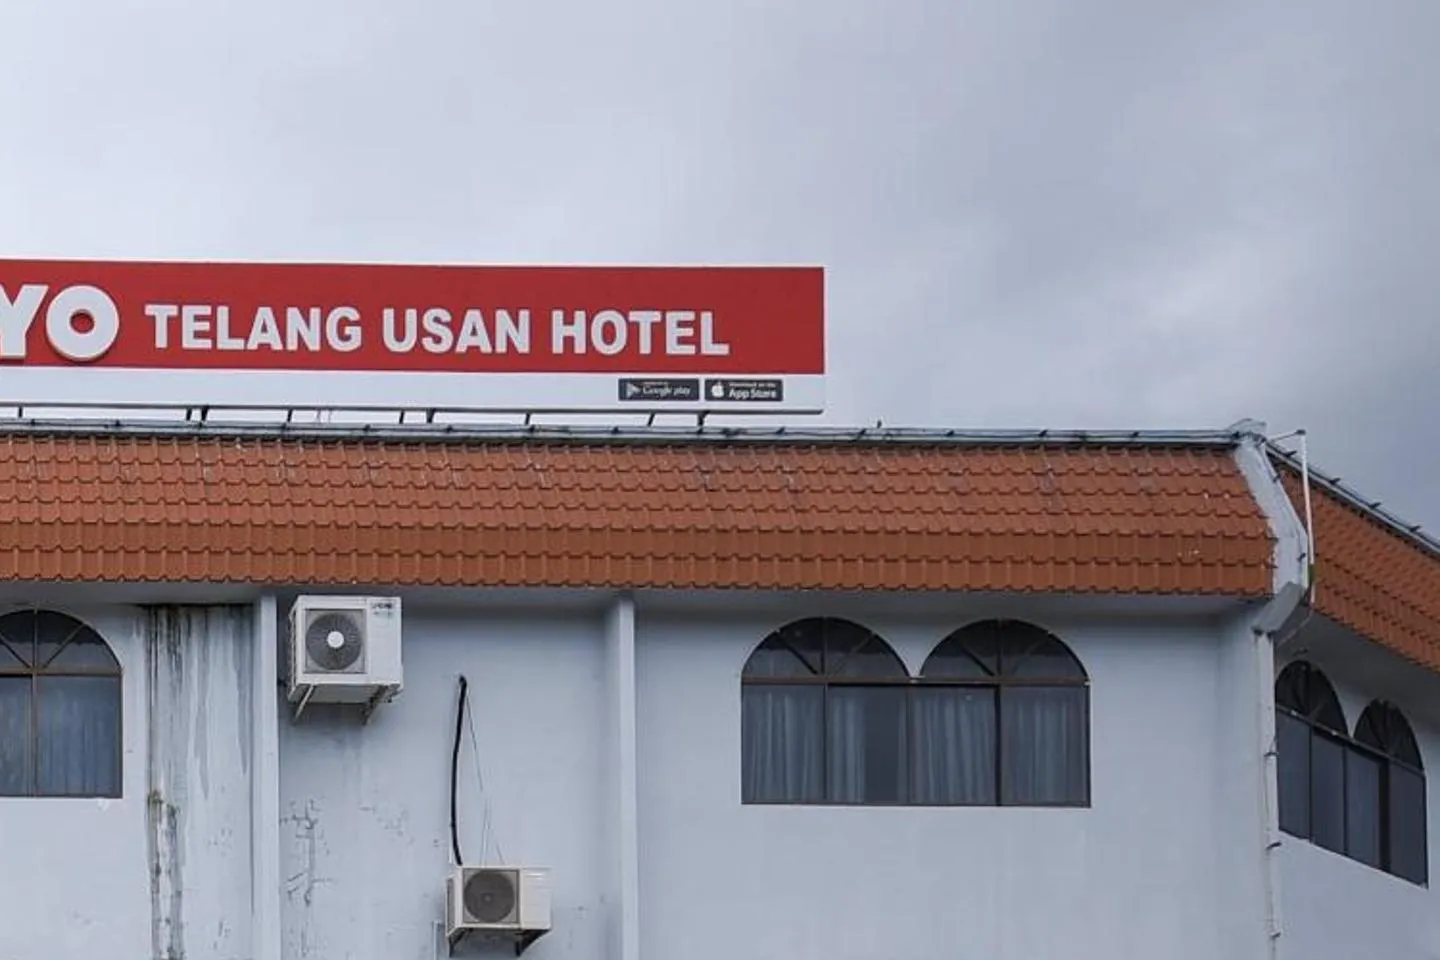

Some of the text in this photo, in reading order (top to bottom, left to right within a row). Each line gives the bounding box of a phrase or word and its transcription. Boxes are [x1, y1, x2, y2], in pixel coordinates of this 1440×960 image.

[144, 303, 362, 352] TELANG
[382, 307, 530, 354] USAN
[551, 309, 730, 355] HOTEL
[728, 388, 777, 400] App Store
